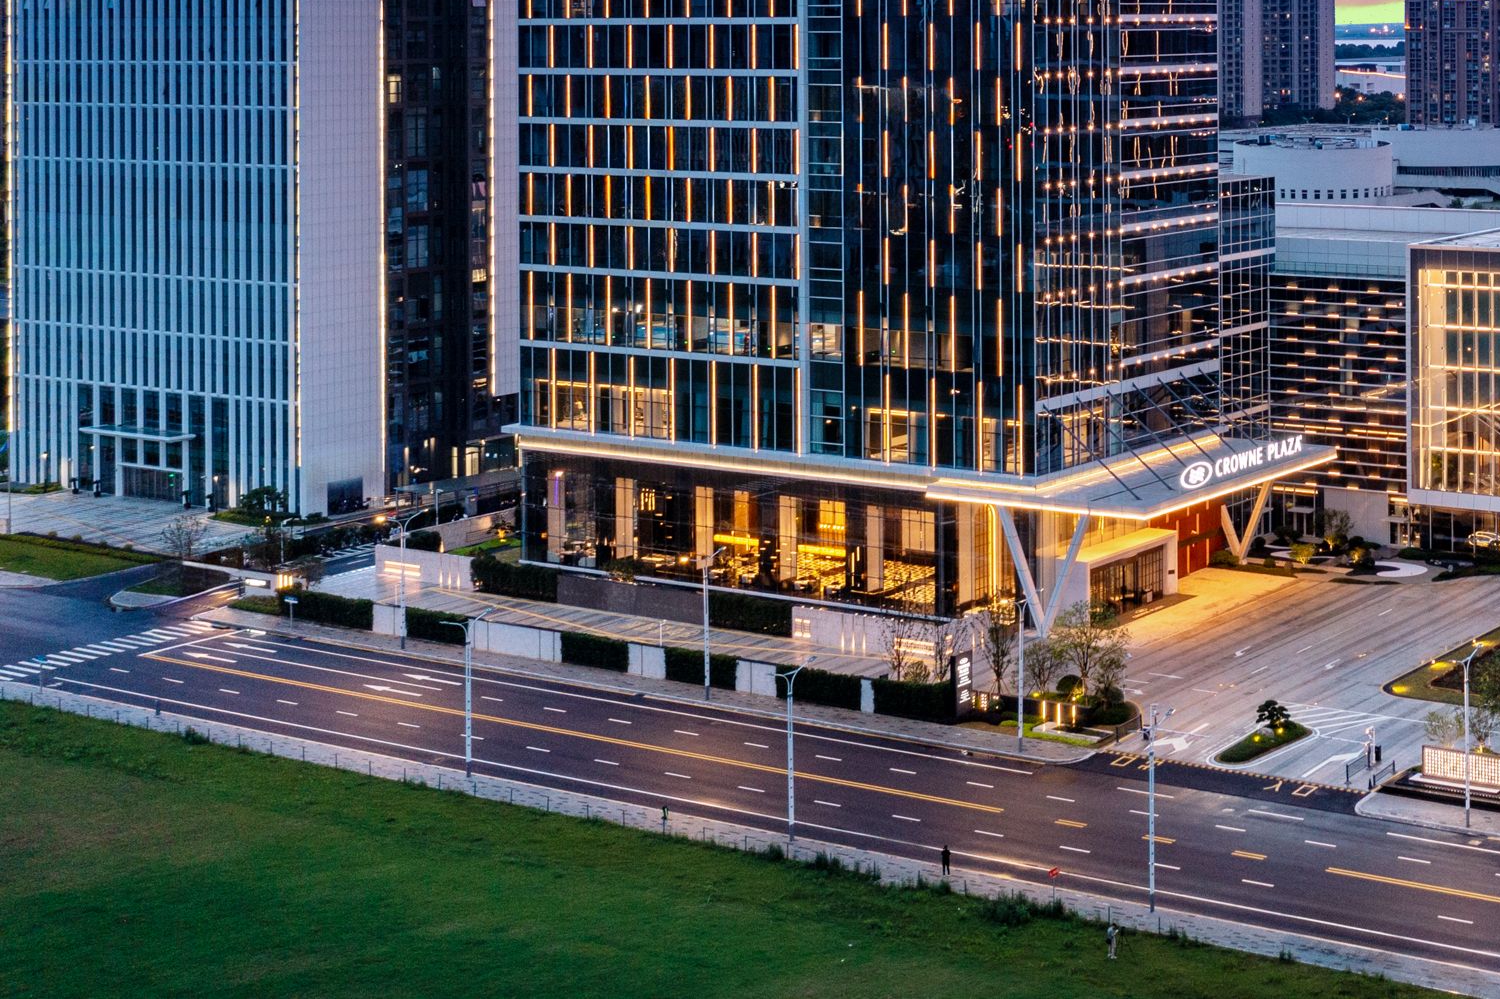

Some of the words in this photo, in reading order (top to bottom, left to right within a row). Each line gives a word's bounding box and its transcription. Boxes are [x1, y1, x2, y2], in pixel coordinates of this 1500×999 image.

[1214, 446, 1264, 478] CROWNE
[1266, 435, 1303, 463] PLAZA
[1263, 780, 1318, 797] 入口
